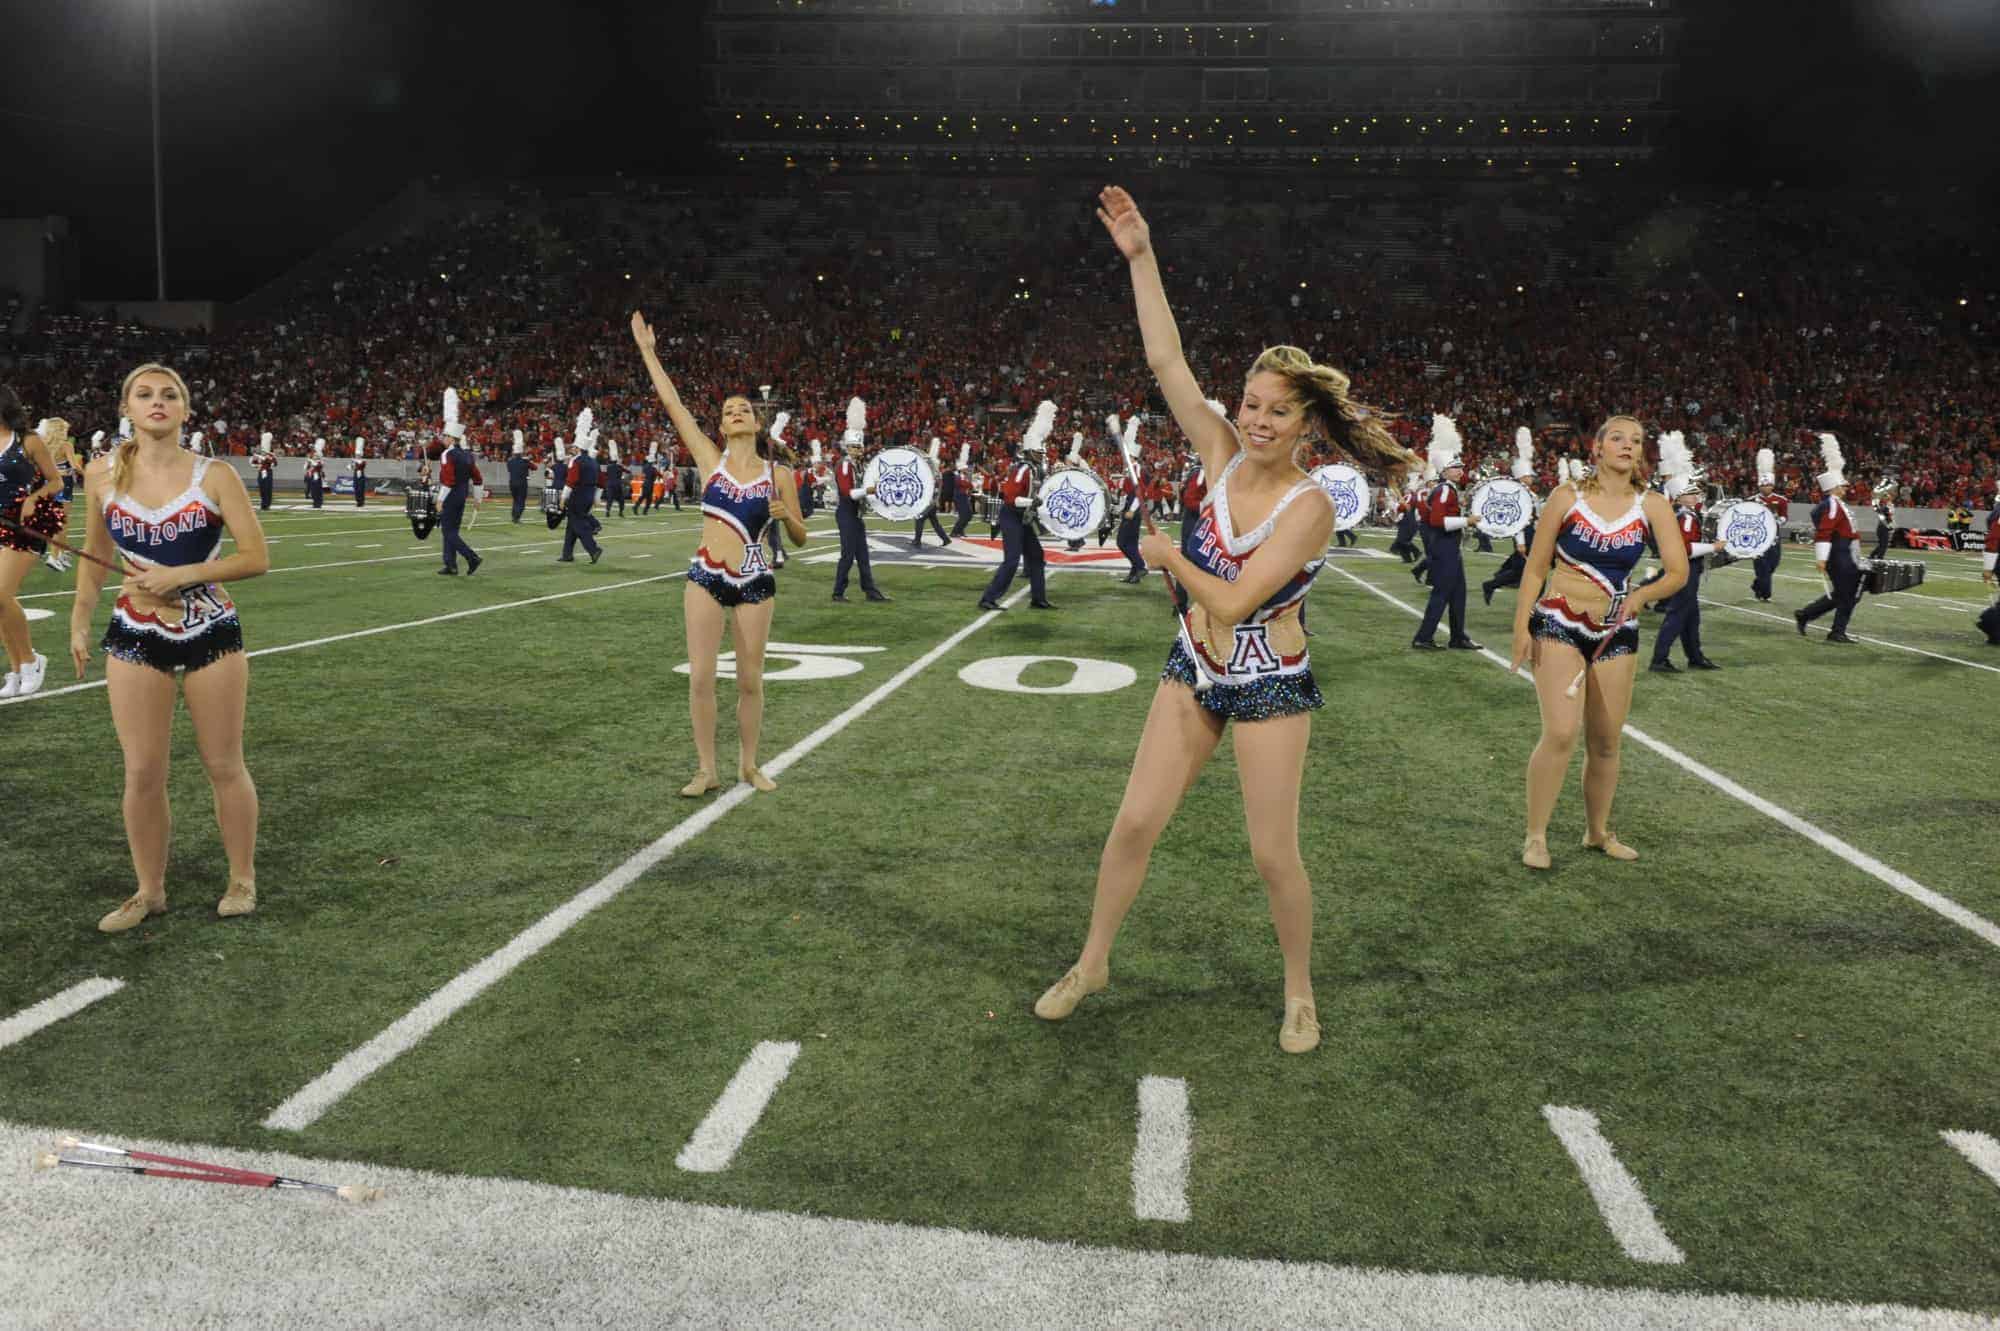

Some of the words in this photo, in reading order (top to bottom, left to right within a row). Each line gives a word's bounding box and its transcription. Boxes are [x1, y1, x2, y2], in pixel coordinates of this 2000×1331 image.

[111, 508, 207, 546] ARIZONA
[1571, 521, 1643, 552] ARIZONA
[741, 544, 769, 574] A
[1195, 517, 1244, 583] ARIZO
[180, 584, 224, 628] A
[1226, 624, 1282, 676] A
